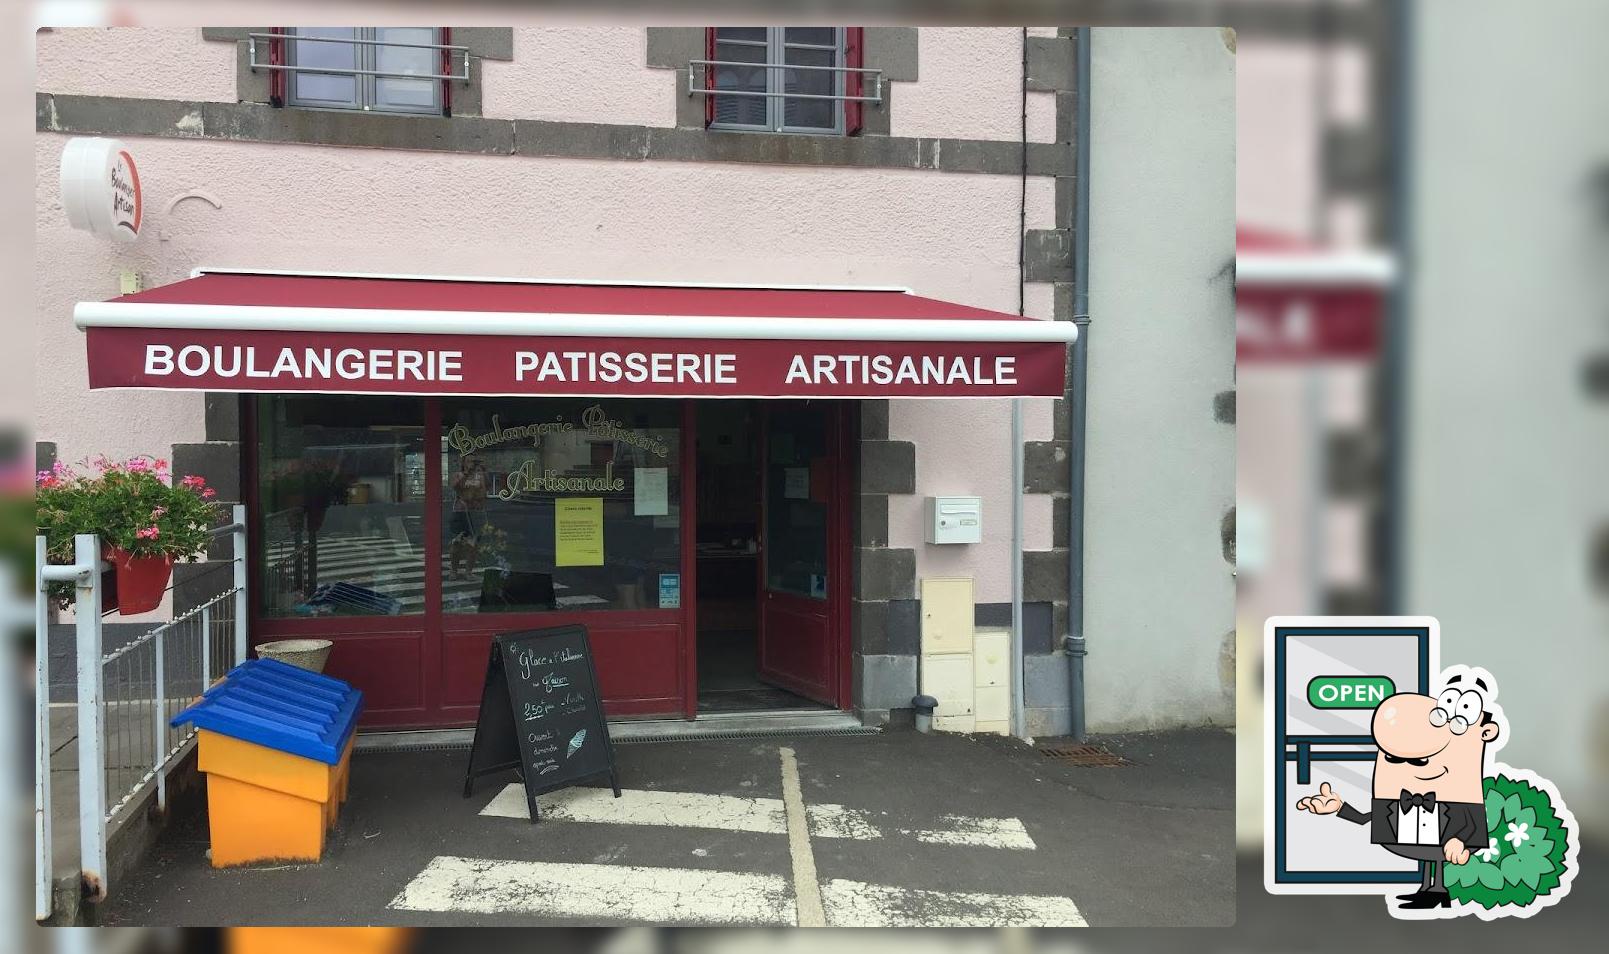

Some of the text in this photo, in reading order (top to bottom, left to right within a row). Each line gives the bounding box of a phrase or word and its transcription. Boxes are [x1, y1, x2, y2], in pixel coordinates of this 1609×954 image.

[114, 191, 134, 217] Artisan
[144, 344, 1017, 385] BOULANGERIE PATISSERIE ARTISANALE
[448, 414, 574, 458] Boulangerie
[499, 460, 625, 501] Artisanale
